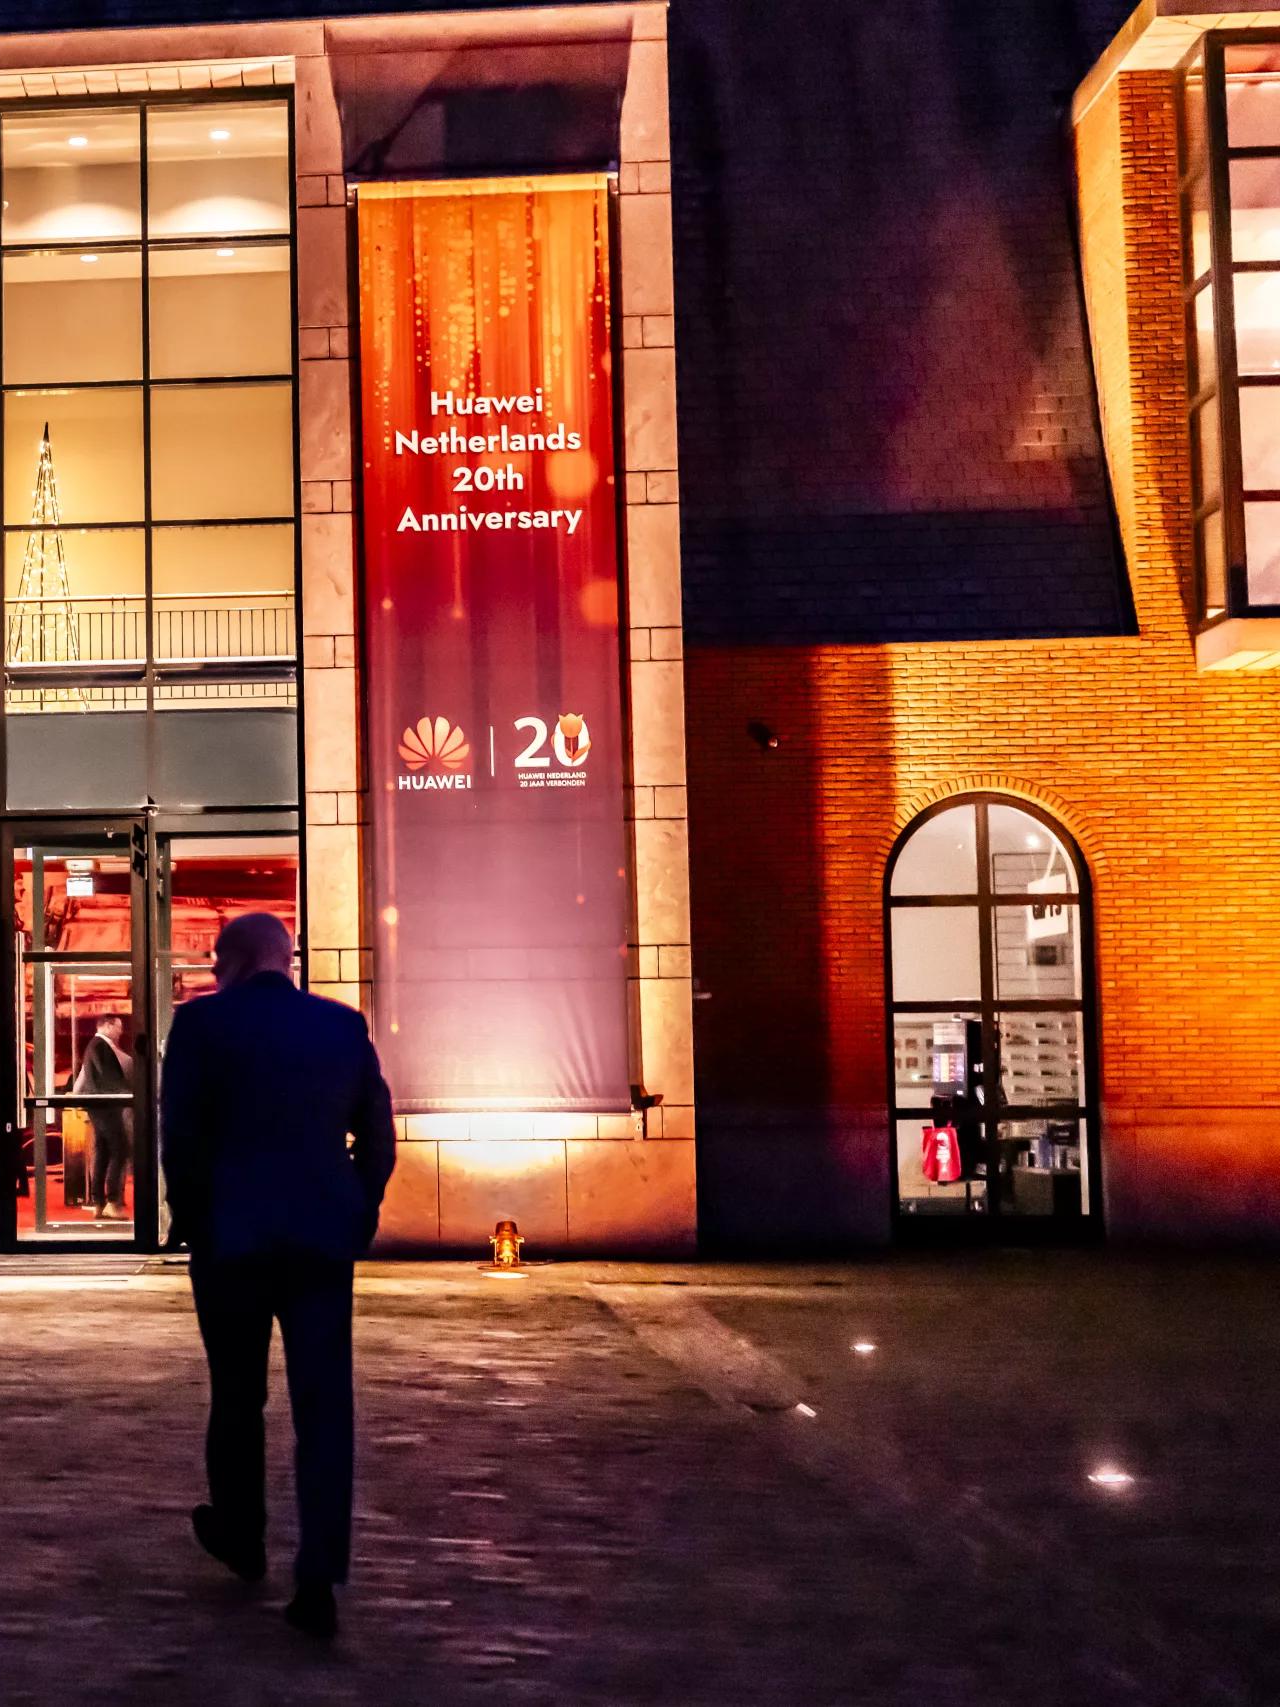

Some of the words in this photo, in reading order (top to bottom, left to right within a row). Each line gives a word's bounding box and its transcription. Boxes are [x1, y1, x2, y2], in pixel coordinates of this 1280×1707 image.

[431, 387, 543, 415] Huawei
[395, 422, 581, 455] Netherlands
[452, 463, 524, 492] 20th
[396, 505, 583, 534] Anniversary
[514, 713, 590, 768] 20
[398, 774, 471, 790] HUAWEI
[518, 772, 545, 780] HUAWEI
[546, 771, 587, 779] NEDERLAND
[520, 780, 528, 788] 20
